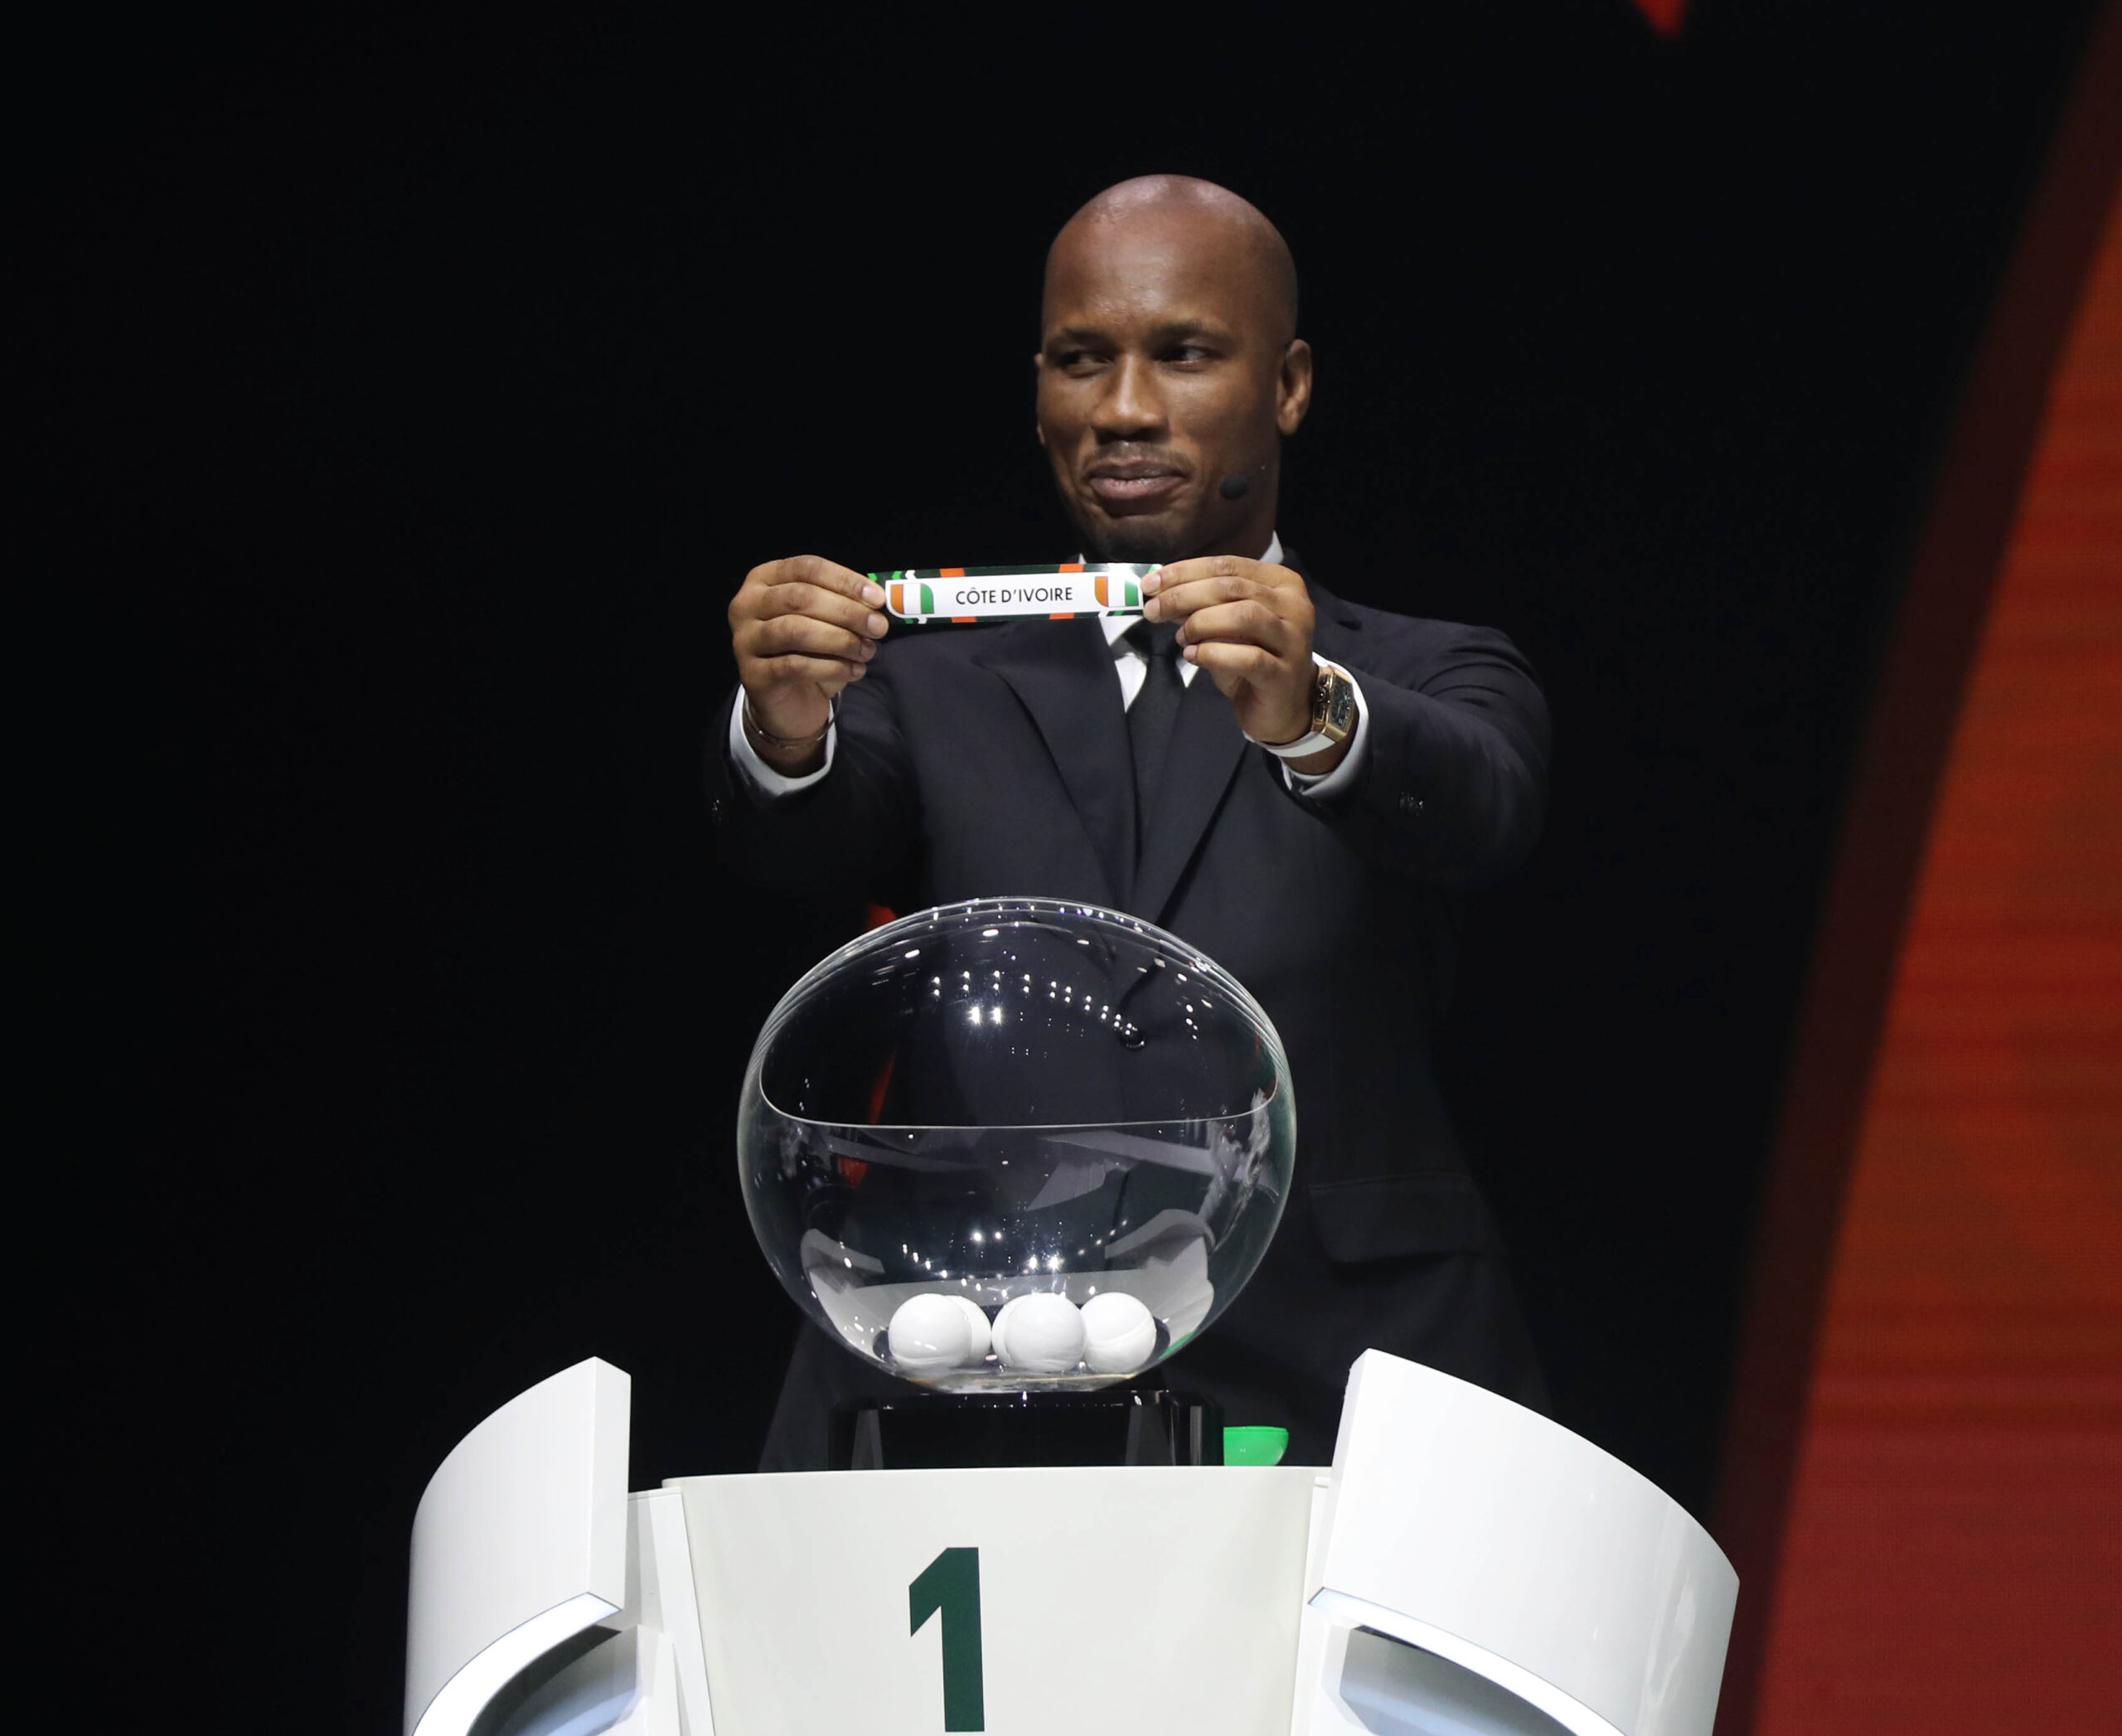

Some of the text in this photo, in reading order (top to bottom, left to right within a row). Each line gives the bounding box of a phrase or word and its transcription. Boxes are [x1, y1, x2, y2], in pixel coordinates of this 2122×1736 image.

[956, 587, 1073, 604] CÔTE D'IVOIRE
[908, 1547, 985, 1732] 1
